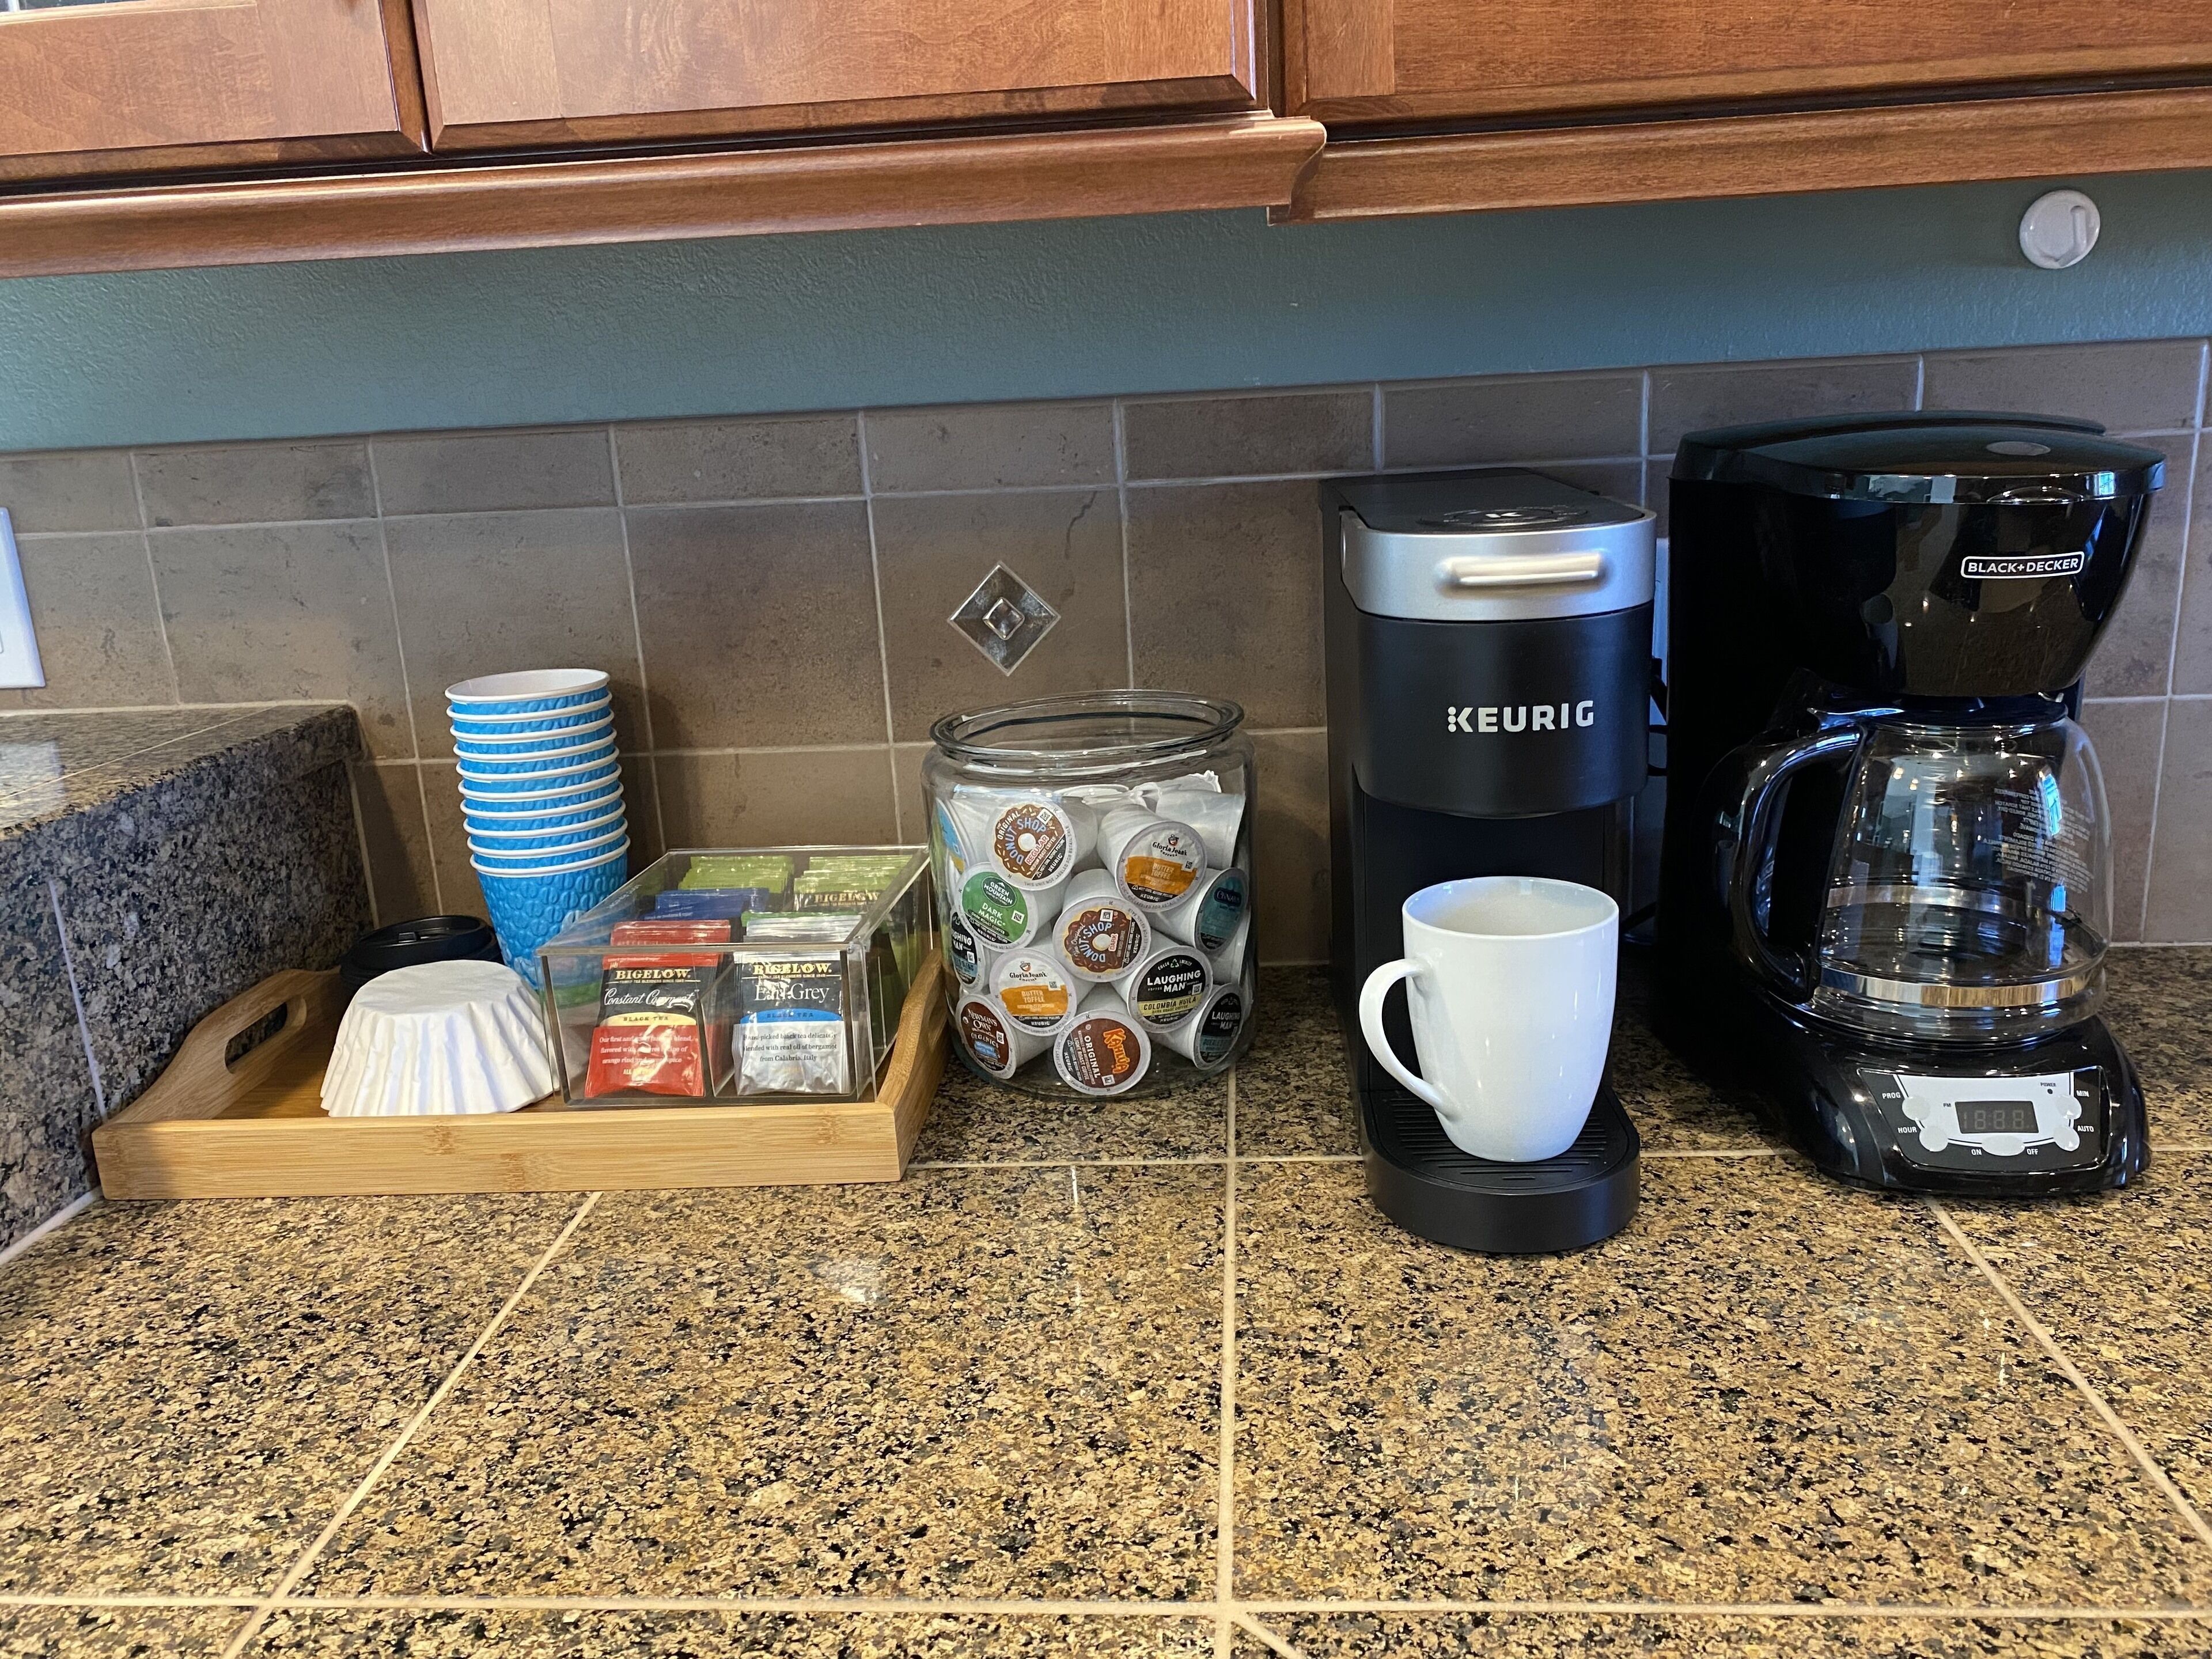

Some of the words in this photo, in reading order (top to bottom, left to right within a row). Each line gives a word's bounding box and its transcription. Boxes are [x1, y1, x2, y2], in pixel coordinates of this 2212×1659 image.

[1968, 558, 2078, 573] BLACK+DECKER
[1448, 700, 1594, 733] KEURIG
[997, 810, 1021, 840] ORIGINAL
[1005, 825, 1025, 865] DONUT
[1017, 817, 1047, 833] SHOP
[1152, 842, 1172, 853] Gloria
[1025, 835, 1049, 865] REGULAR
[1048, 853, 1063, 872] KEURIG
[1152, 863, 1174, 873] BUTTER
[984, 884, 1013, 904] MOUNTAIN
[990, 881, 1009, 897] GREEN
[1140, 893, 1161, 902] KEURIG
[982, 902, 1003, 920] DARK
[1071, 922, 1086, 945] Original
[1083, 922, 1112, 938] SHOP
[1109, 934, 1118, 950] DARK
[1132, 934, 1141, 954] KEURIG
[1079, 938, 1106, 963] DONUT
[615, 969, 691, 979] BIGELOW
[753, 961, 830, 975] BIGELOW
[1158, 961, 1169, 971] CHECK
[1147, 970, 1201, 986] LAUGHING
[790, 983, 830, 1003] Grey
[1164, 982, 1185, 993] MAN
[1143, 1001, 1176, 1010] COLOMBIA
[1179, 997, 1196, 1005] HUILA
[1211, 1012, 1240, 1020] LAUGHING
[1220, 1021, 1232, 1029] MAN
[1063, 1052, 1073, 1071] KEURIG
[1073, 1037, 1081, 1050] LIGHT
[1077, 1050, 1085, 1066] ROAST
[1081, 1066, 1090, 1081] COFFEE
[1084, 1035, 1101, 1078] ORIGINAL
[1897, 1126, 1917, 1134] HOUR
